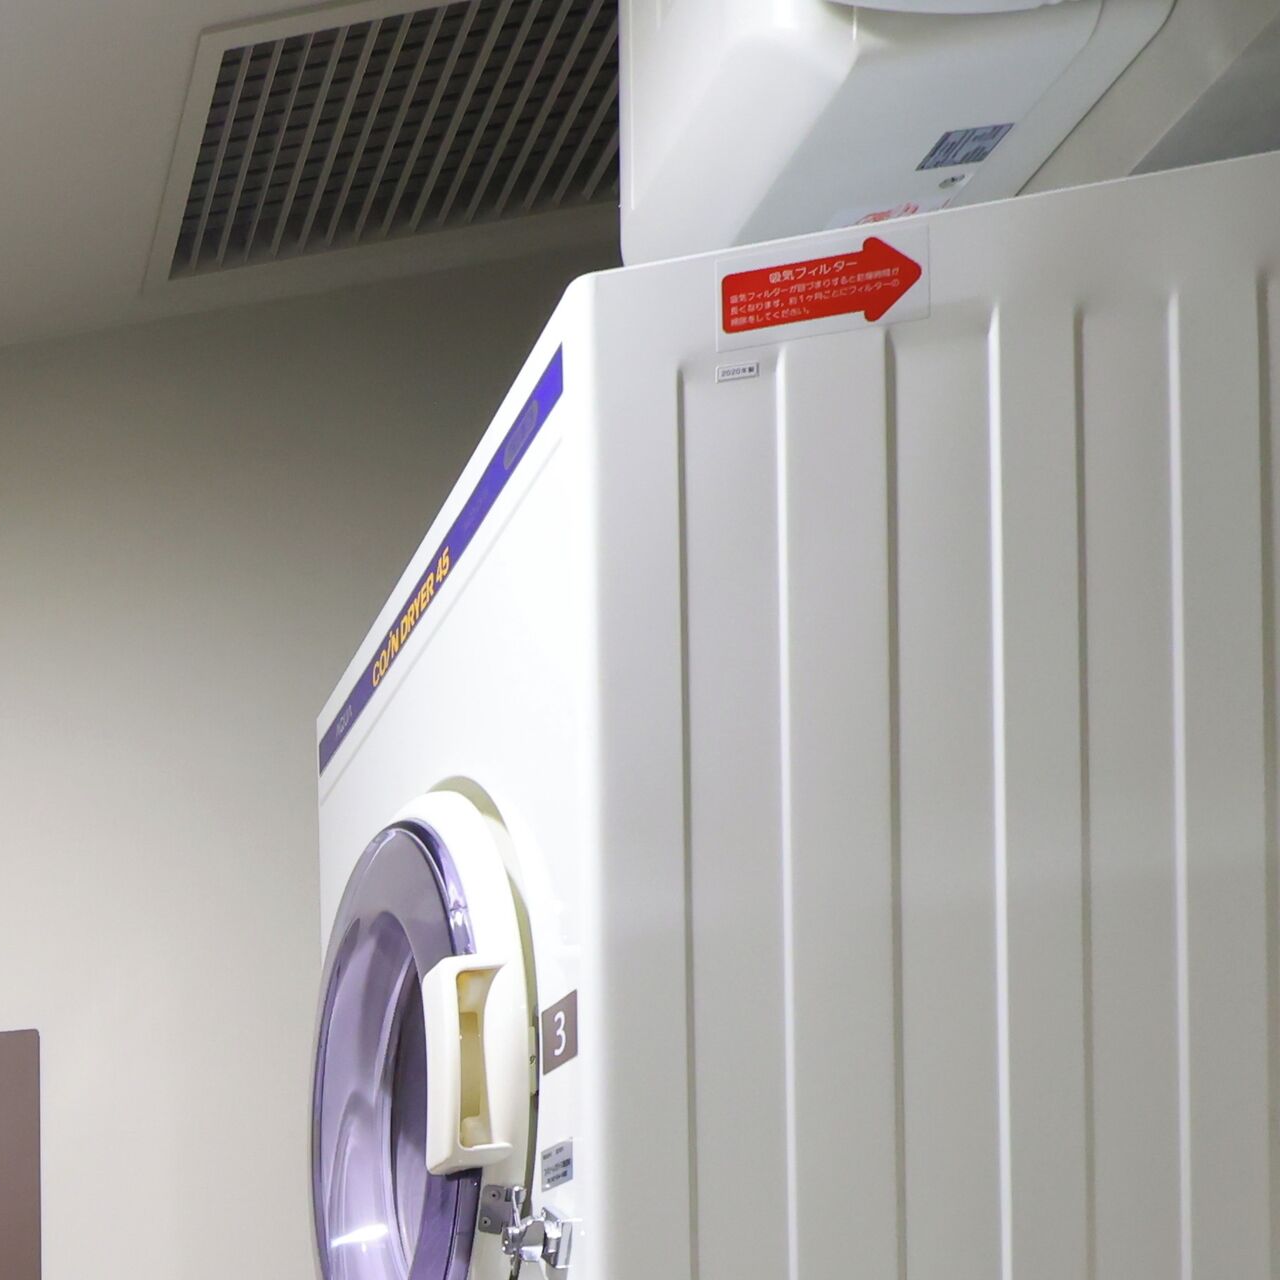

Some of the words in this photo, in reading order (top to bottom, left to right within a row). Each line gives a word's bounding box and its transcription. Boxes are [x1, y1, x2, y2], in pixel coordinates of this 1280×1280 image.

[769, 260, 858, 284] 吸気フィルター
[371, 630, 400, 687] COIN
[400, 573, 434, 641] DRYER
[435, 547, 450, 584] 45
[554, 1013, 567, 1056] 3
